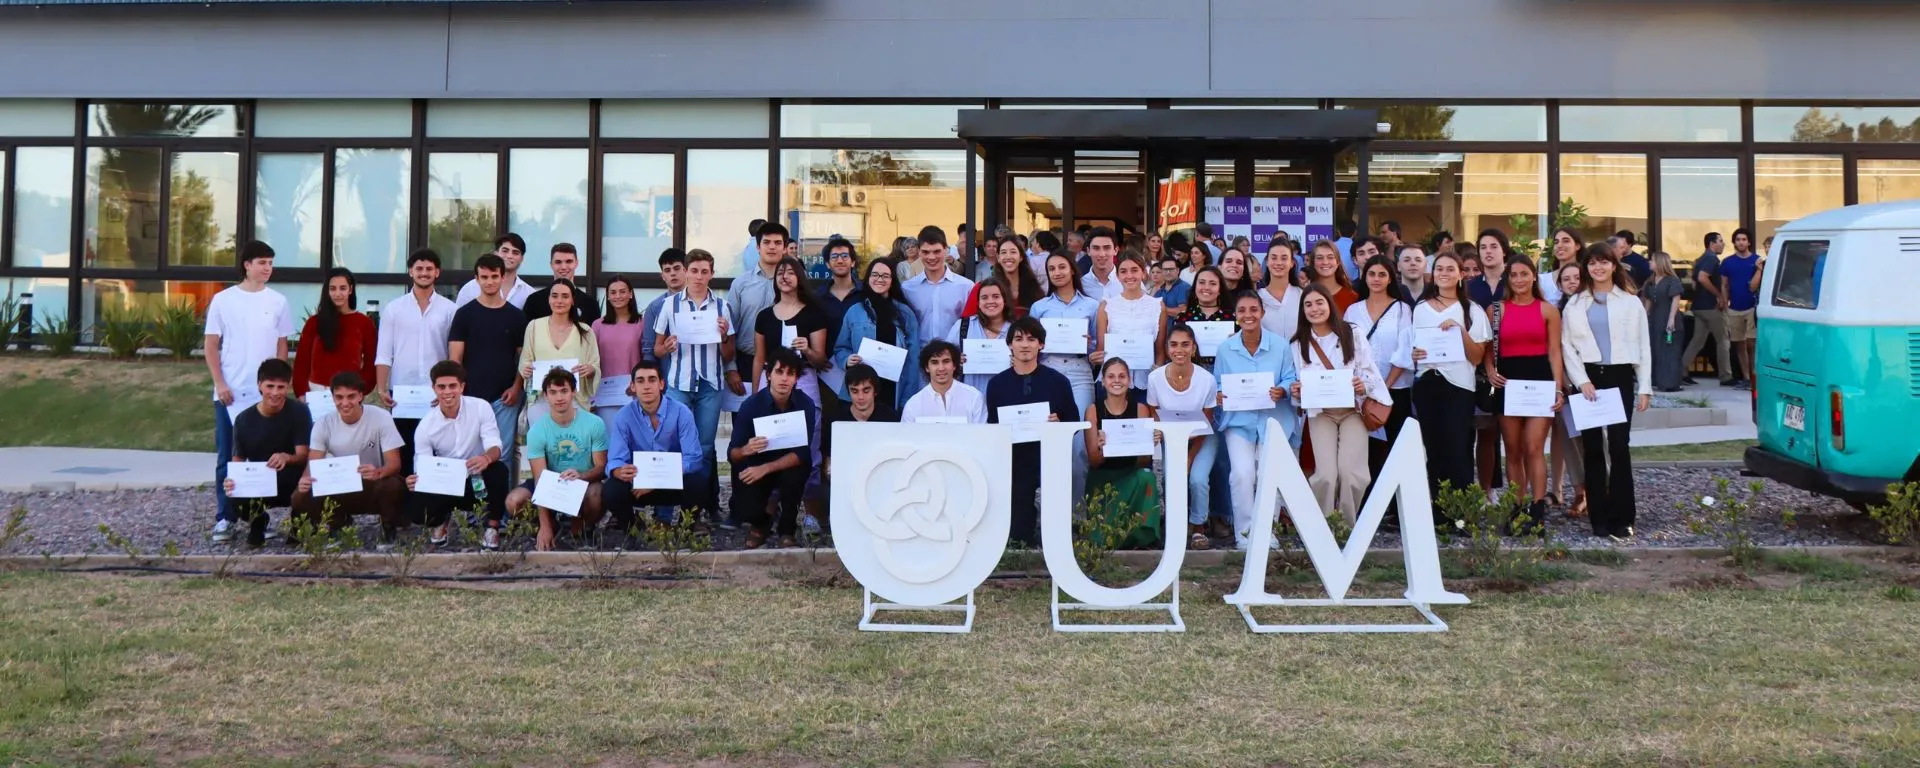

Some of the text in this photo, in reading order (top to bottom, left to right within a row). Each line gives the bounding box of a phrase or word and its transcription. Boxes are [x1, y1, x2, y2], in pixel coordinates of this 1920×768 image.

[1207, 205, 1221, 213] UM
[1234, 205, 1248, 213] UM
[1261, 205, 1275, 213] UM
[1288, 205, 1302, 213] UM
[1315, 205, 1329, 213] UM
[1018, 416, 1471, 605] UM
